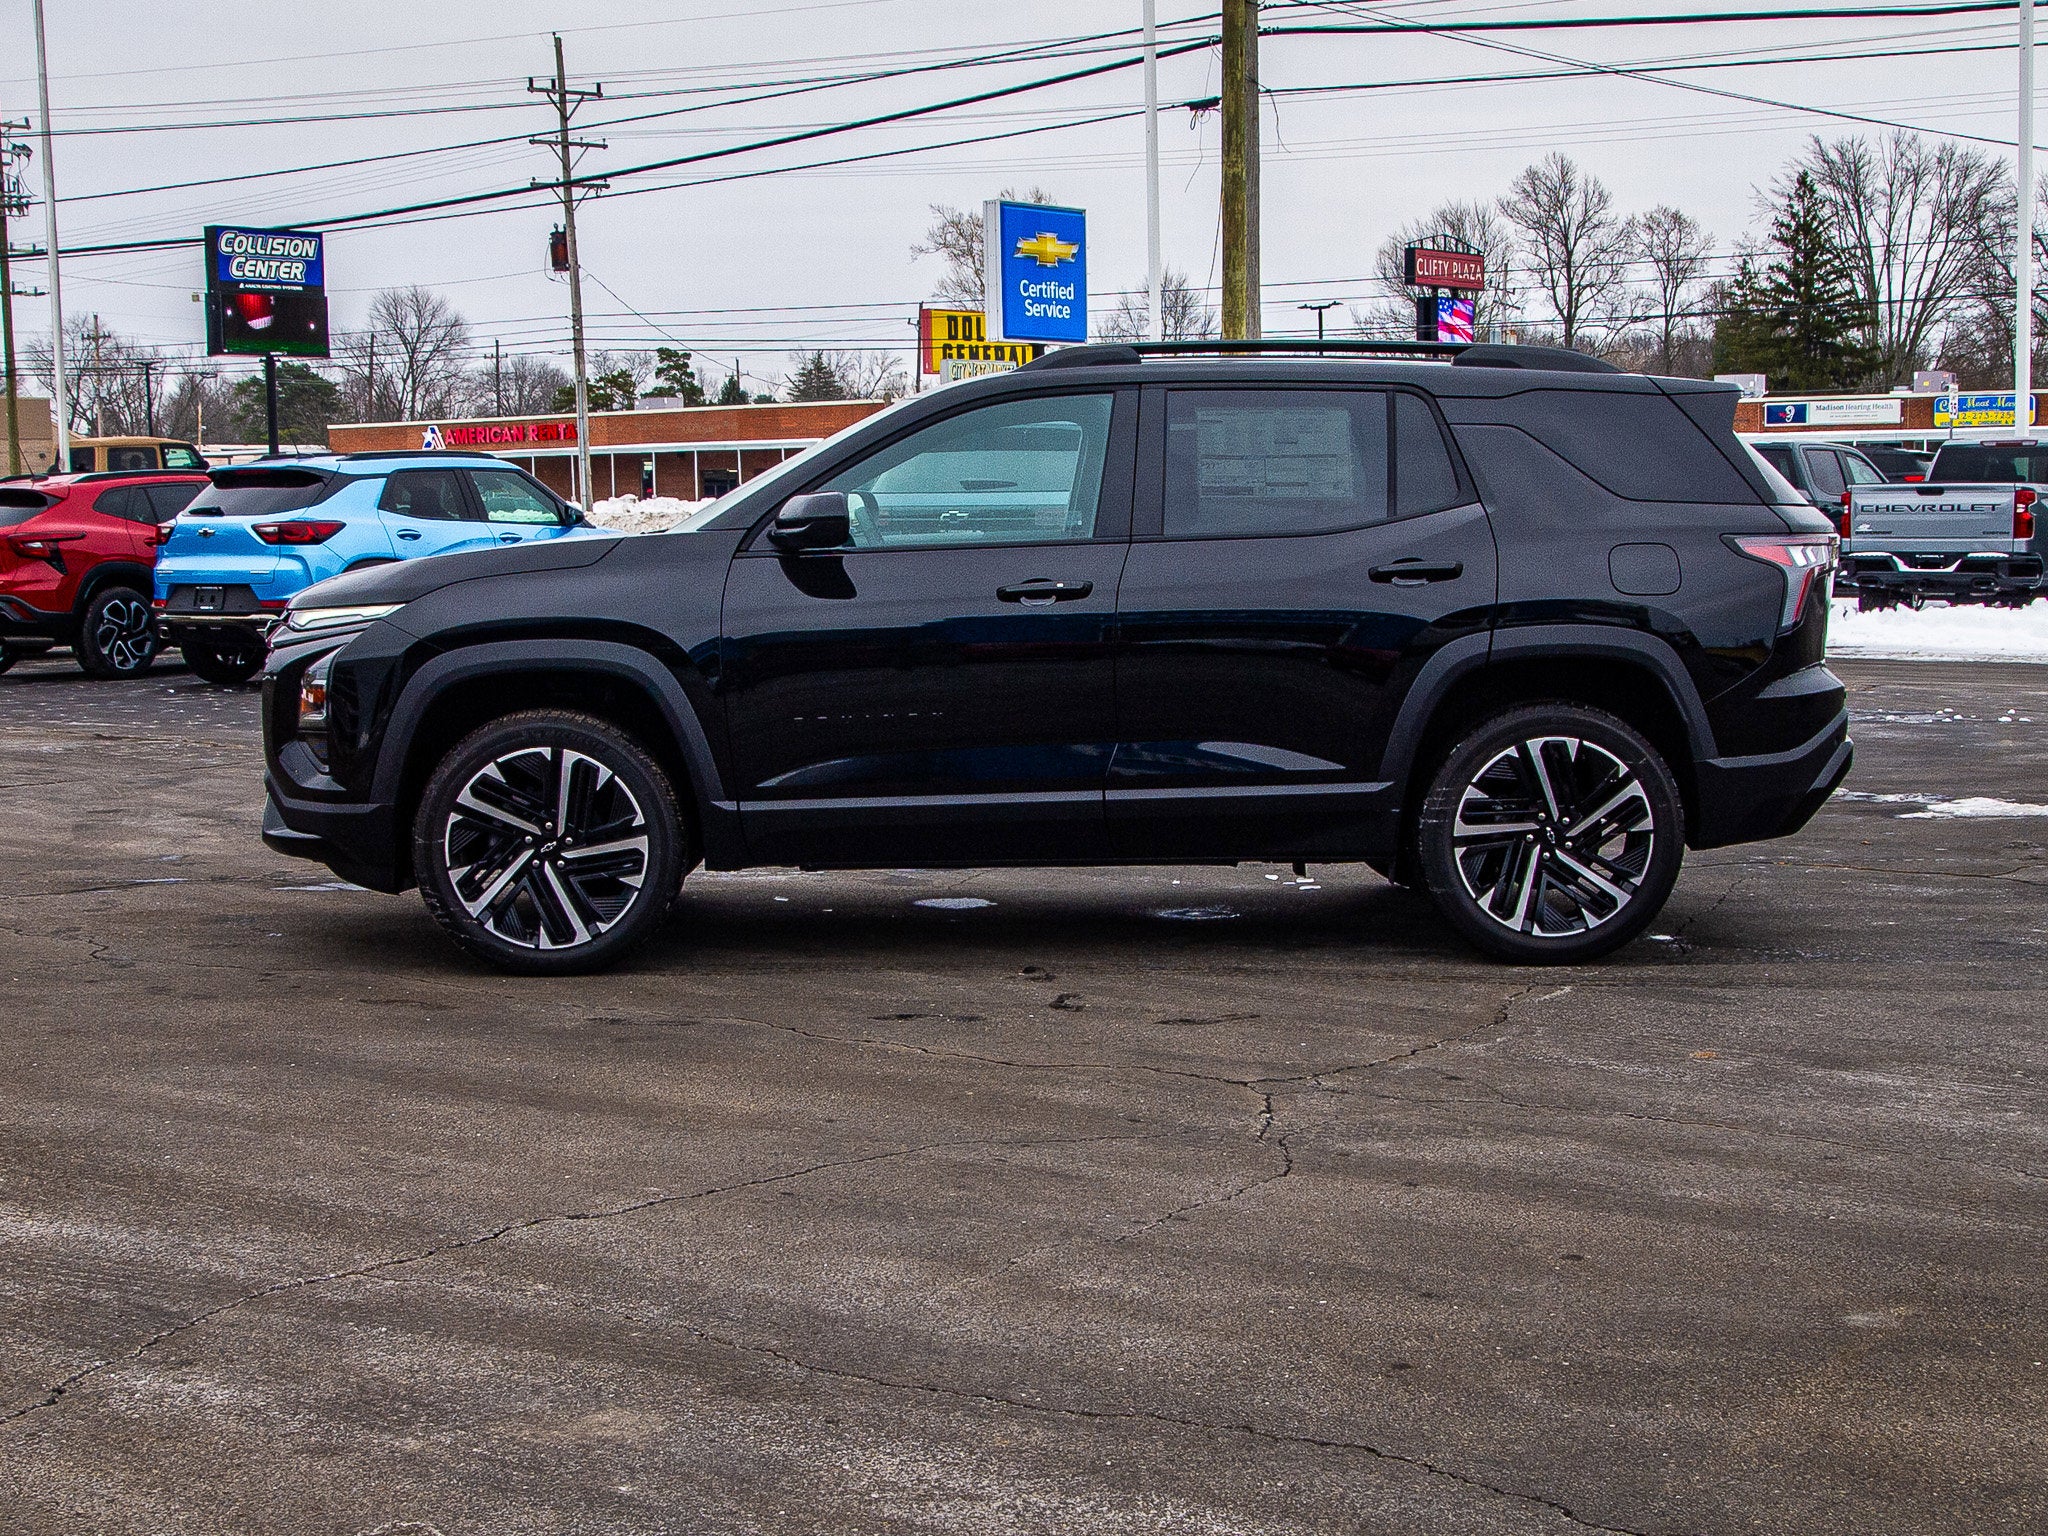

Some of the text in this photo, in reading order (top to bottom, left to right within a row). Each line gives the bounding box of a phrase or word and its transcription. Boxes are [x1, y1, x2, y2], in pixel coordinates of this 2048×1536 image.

[219, 231, 317, 258] COLLISION
[230, 256, 305, 281] CENTER
[1416, 258, 1482, 281] CLIFTY PLAZA
[1020, 279, 1074, 300] Certified
[1025, 299, 1071, 319] Service
[947, 315, 985, 342] DOL
[1816, 403, 1844, 411] Madison
[1845, 403, 1871, 411] Hearing
[445, 423, 577, 445] AMERICAN RENTA
[1860, 503, 2002, 513] CHEVROLET
